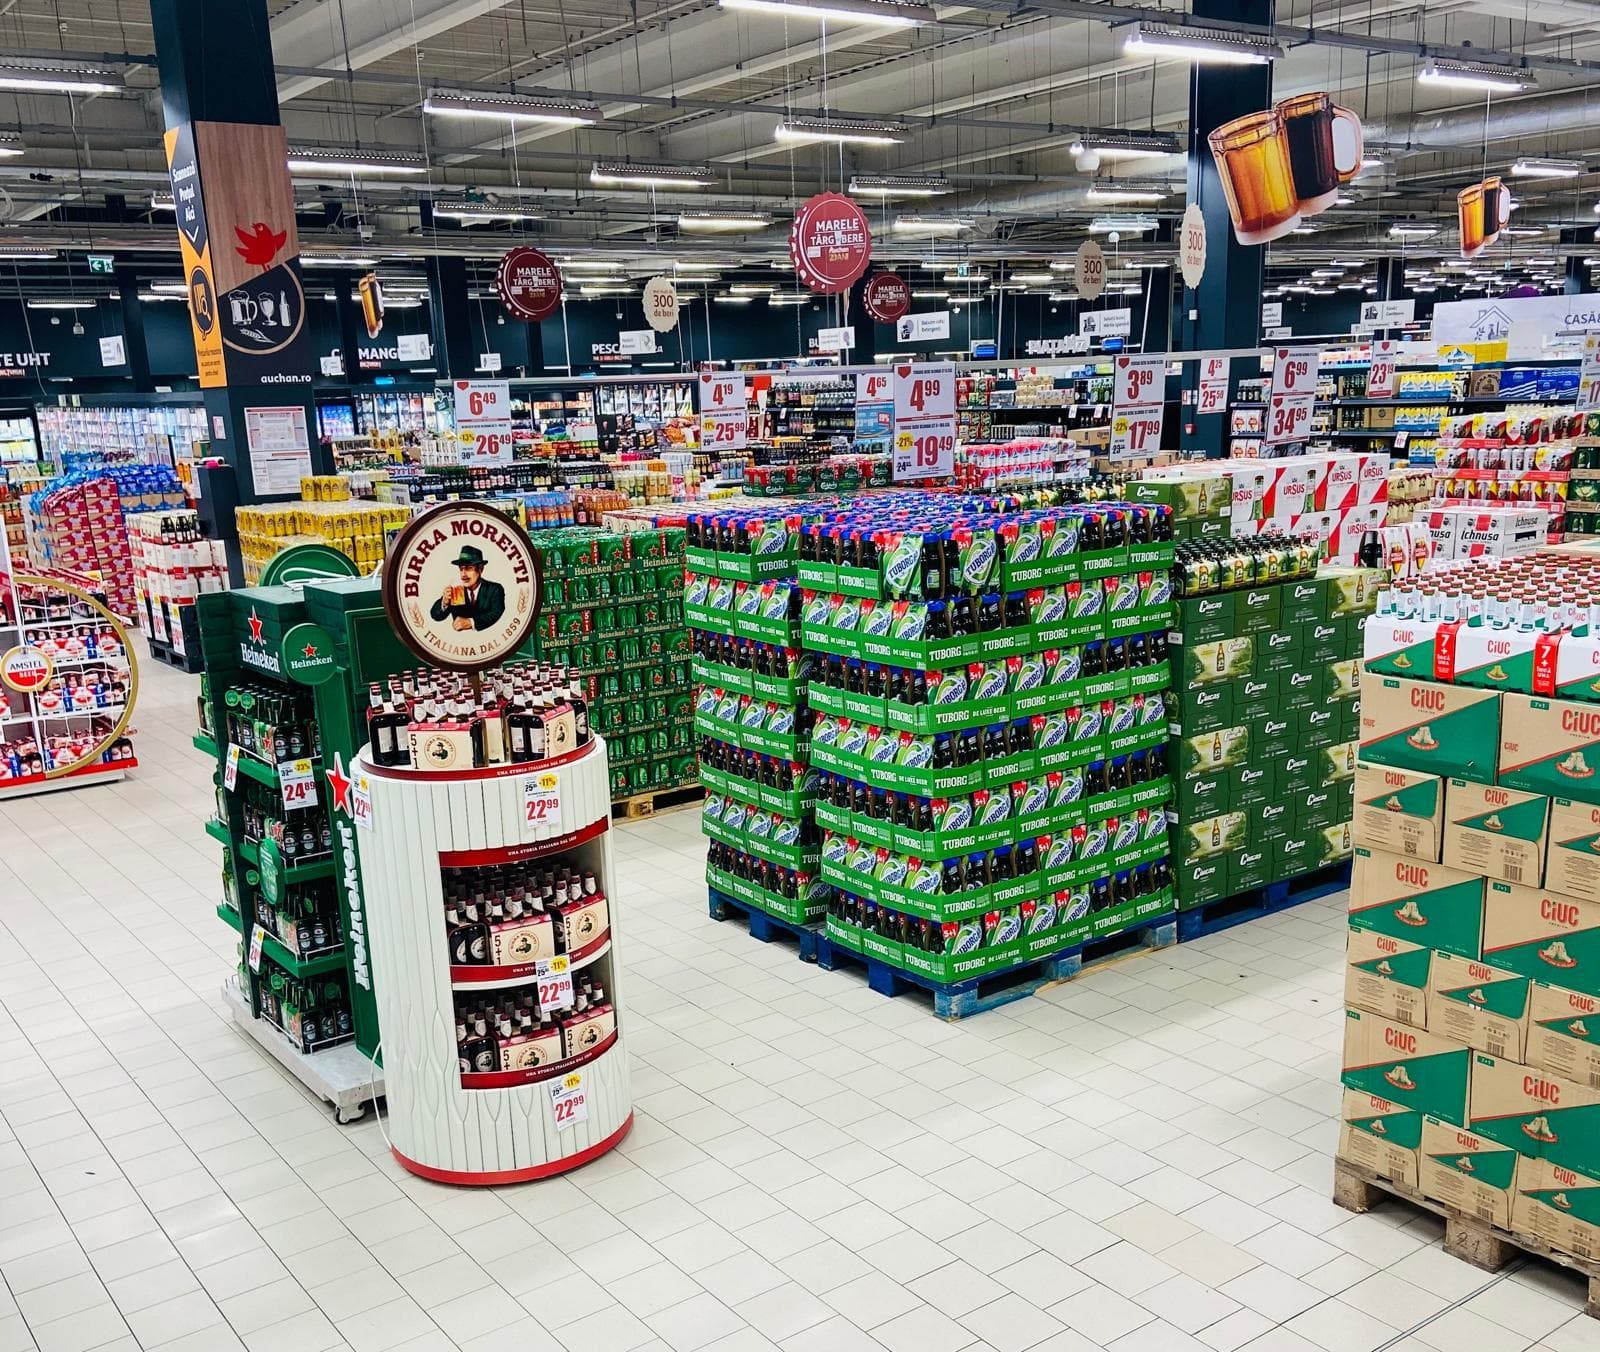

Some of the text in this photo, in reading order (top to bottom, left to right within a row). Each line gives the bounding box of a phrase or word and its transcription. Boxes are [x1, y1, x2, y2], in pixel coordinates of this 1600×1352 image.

[185, 204, 196, 222] Aici
[816, 218, 859, 232] MARELE
[841, 233, 864, 244] BERE
[1187, 230, 1203, 250] 300
[517, 267, 551, 276] MARELE
[1083, 260, 1102, 274] 300
[538, 278, 556, 286] BERE
[653, 294, 674, 308] 300
[16, 353, 51, 366] UHT
[260, 373, 311, 383] auchan.ro
[1332, 470, 1352, 482] URSUS
[1364, 467, 1383, 478] URSUS
[1283, 484, 1305, 496] URSUS
[1347, 523, 1368, 535] URSUS
[405, 519, 529, 598] BIRRA MORETTI
[643, 557, 679, 567] Heineken
[1131, 551, 1159, 563] TUBORG
[575, 565, 612, 576] Heineken
[757, 560, 788, 572] TUBORG
[800, 569, 823, 580] TUBORG
[1011, 567, 1042, 582] TUBORG
[572, 601, 600, 609] Heineken
[424, 618, 521, 656] ITALIANA DAL 1859
[599, 630, 625, 638] Heineken
[805, 631, 829, 644] TUBORG
[1441, 634, 1451, 646] 7
[542, 639, 570, 649] ineken
[240, 642, 280, 673] Heineken
[930, 646, 961, 661] TUBORG
[1541, 646, 1552, 658] 7
[10, 660, 42, 671] AMSTEL
[291, 656, 333, 670] Heineken
[623, 660, 649, 669] Heineken
[1085, 682, 1114, 696] TUBORG
[888, 709, 913, 724] TUBORG
[628, 724, 654, 732] Heineken
[1111, 736, 1138, 750] TUBORG
[814, 749, 837, 764] TUBORG
[528, 763, 550, 771] ITALIANA
[539, 778, 556, 787] -11%
[935, 775, 968, 789] TUBORG
[1089, 799, 1117, 814] TUBORG
[539, 842, 559, 850] ITALIANA
[895, 834, 921, 849] TUBORG
[1048, 871, 1076, 886] TUBORG
[944, 899, 976, 914] TUBORG
[1137, 901, 1162, 915] TUBORG
[550, 961, 567, 971] -11%
[953, 958, 985, 973] TUBORG
[564, 1077, 581, 1087] -11%
